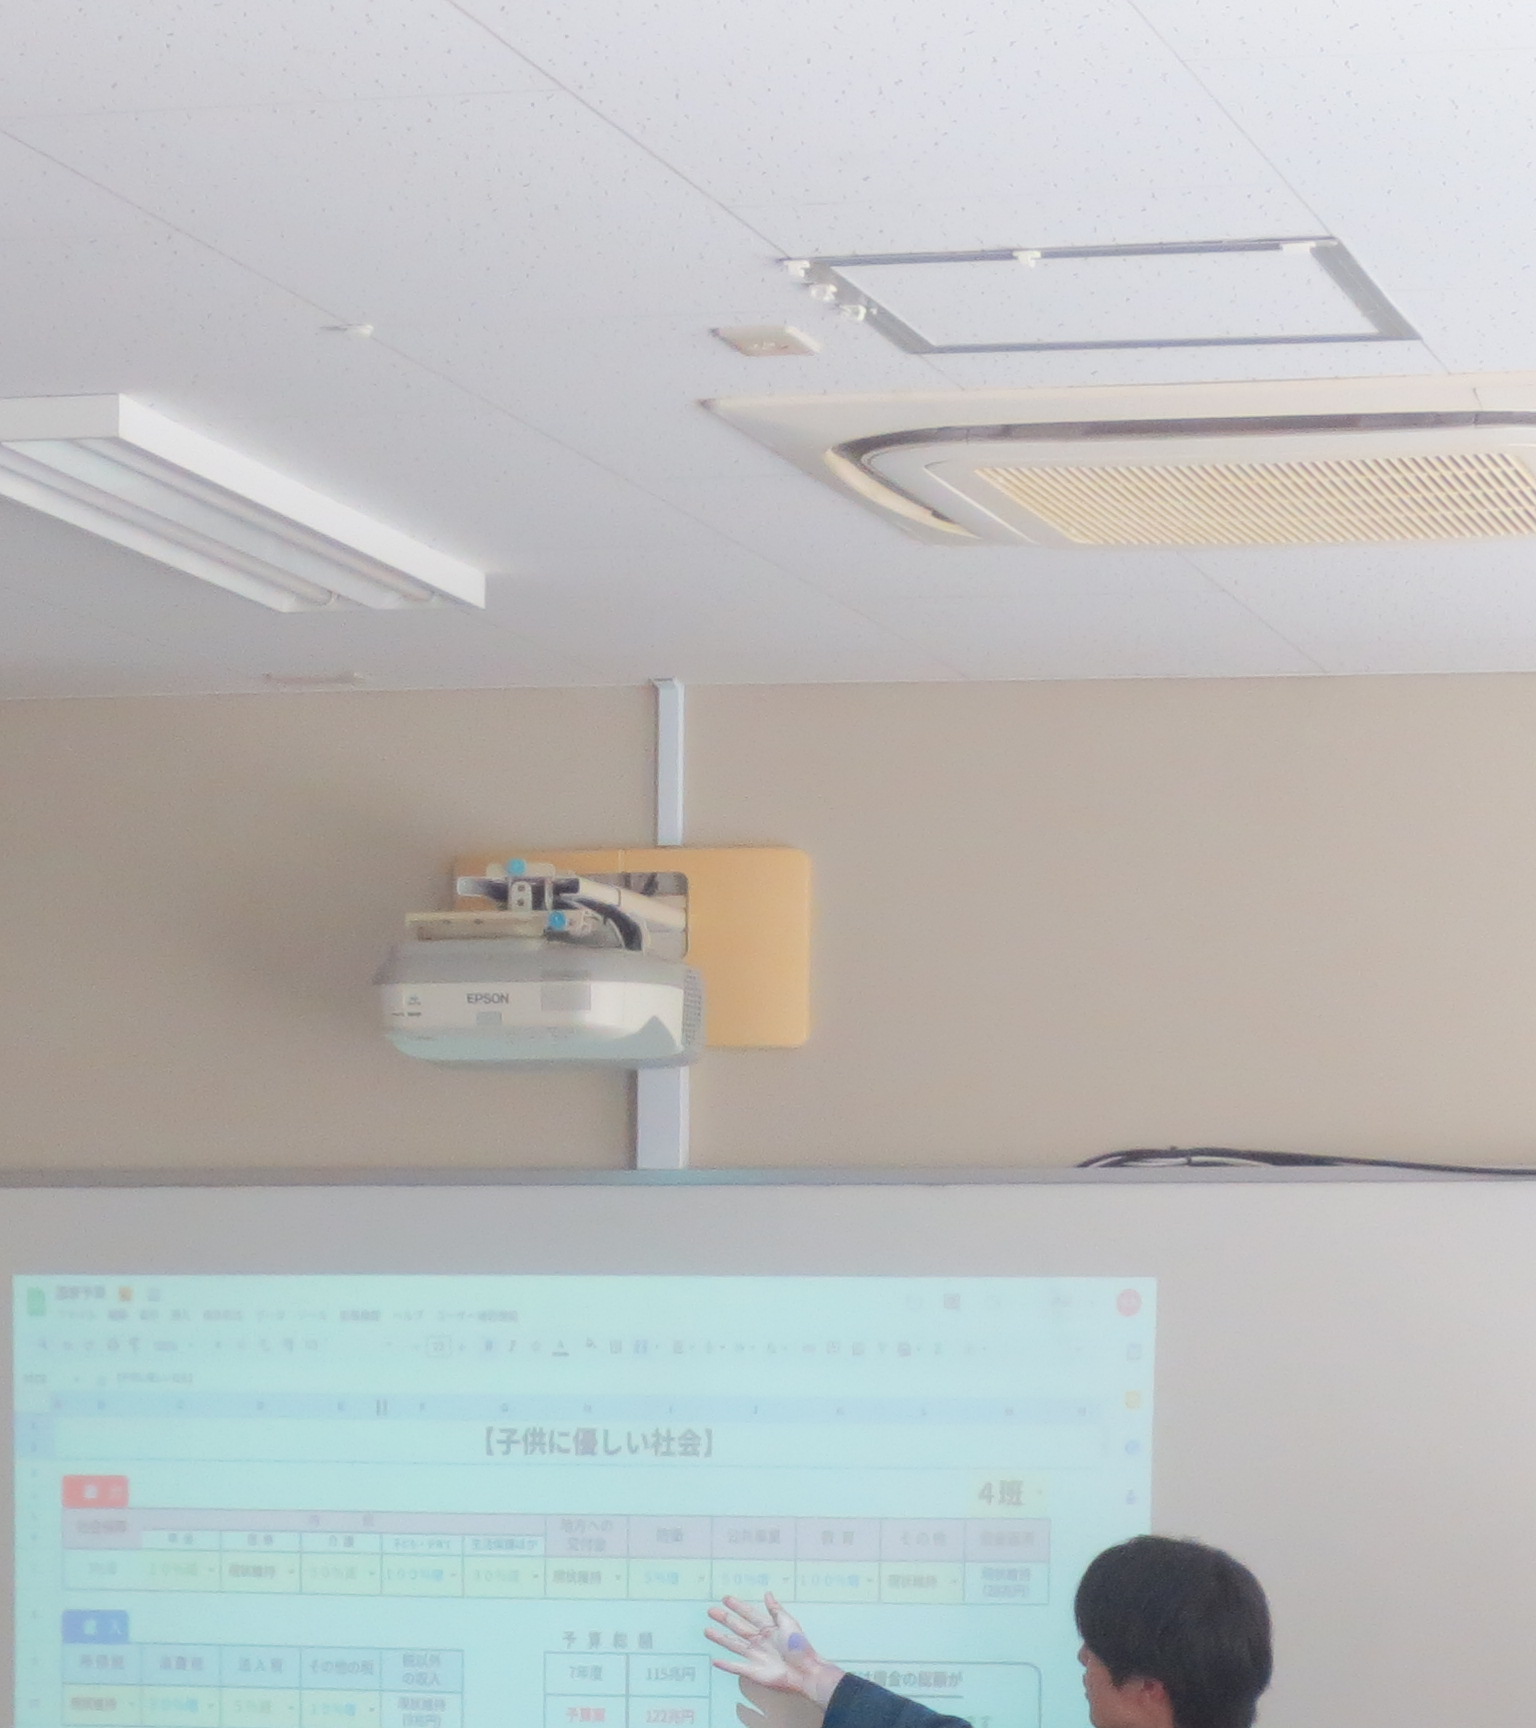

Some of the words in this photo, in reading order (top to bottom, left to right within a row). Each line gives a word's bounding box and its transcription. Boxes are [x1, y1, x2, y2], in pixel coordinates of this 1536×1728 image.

[466, 992, 509, 1005] EPSON
[486, 1426, 713, 1458] 【子供に優しい社会】
